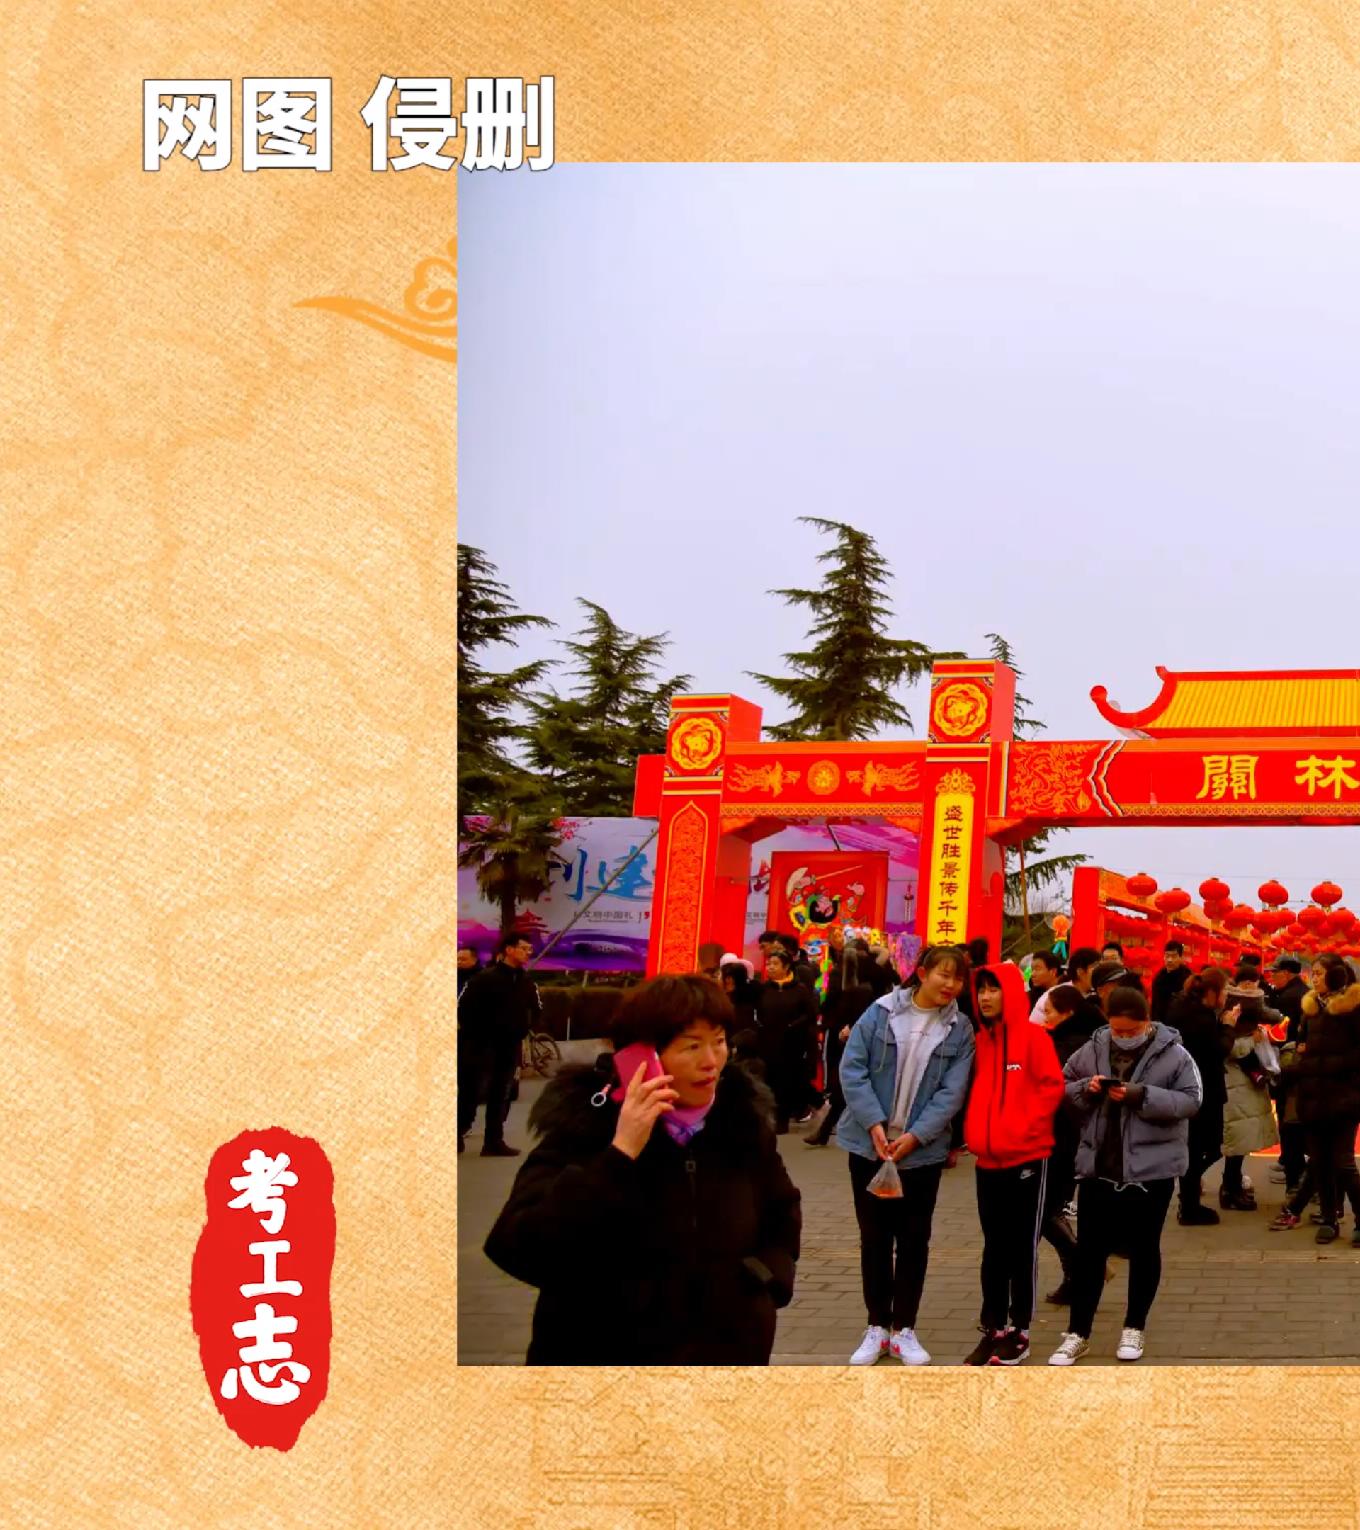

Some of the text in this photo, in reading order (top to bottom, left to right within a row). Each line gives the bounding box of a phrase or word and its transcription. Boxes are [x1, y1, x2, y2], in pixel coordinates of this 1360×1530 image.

[936, 805, 963, 946] 盛世胜景传千年
